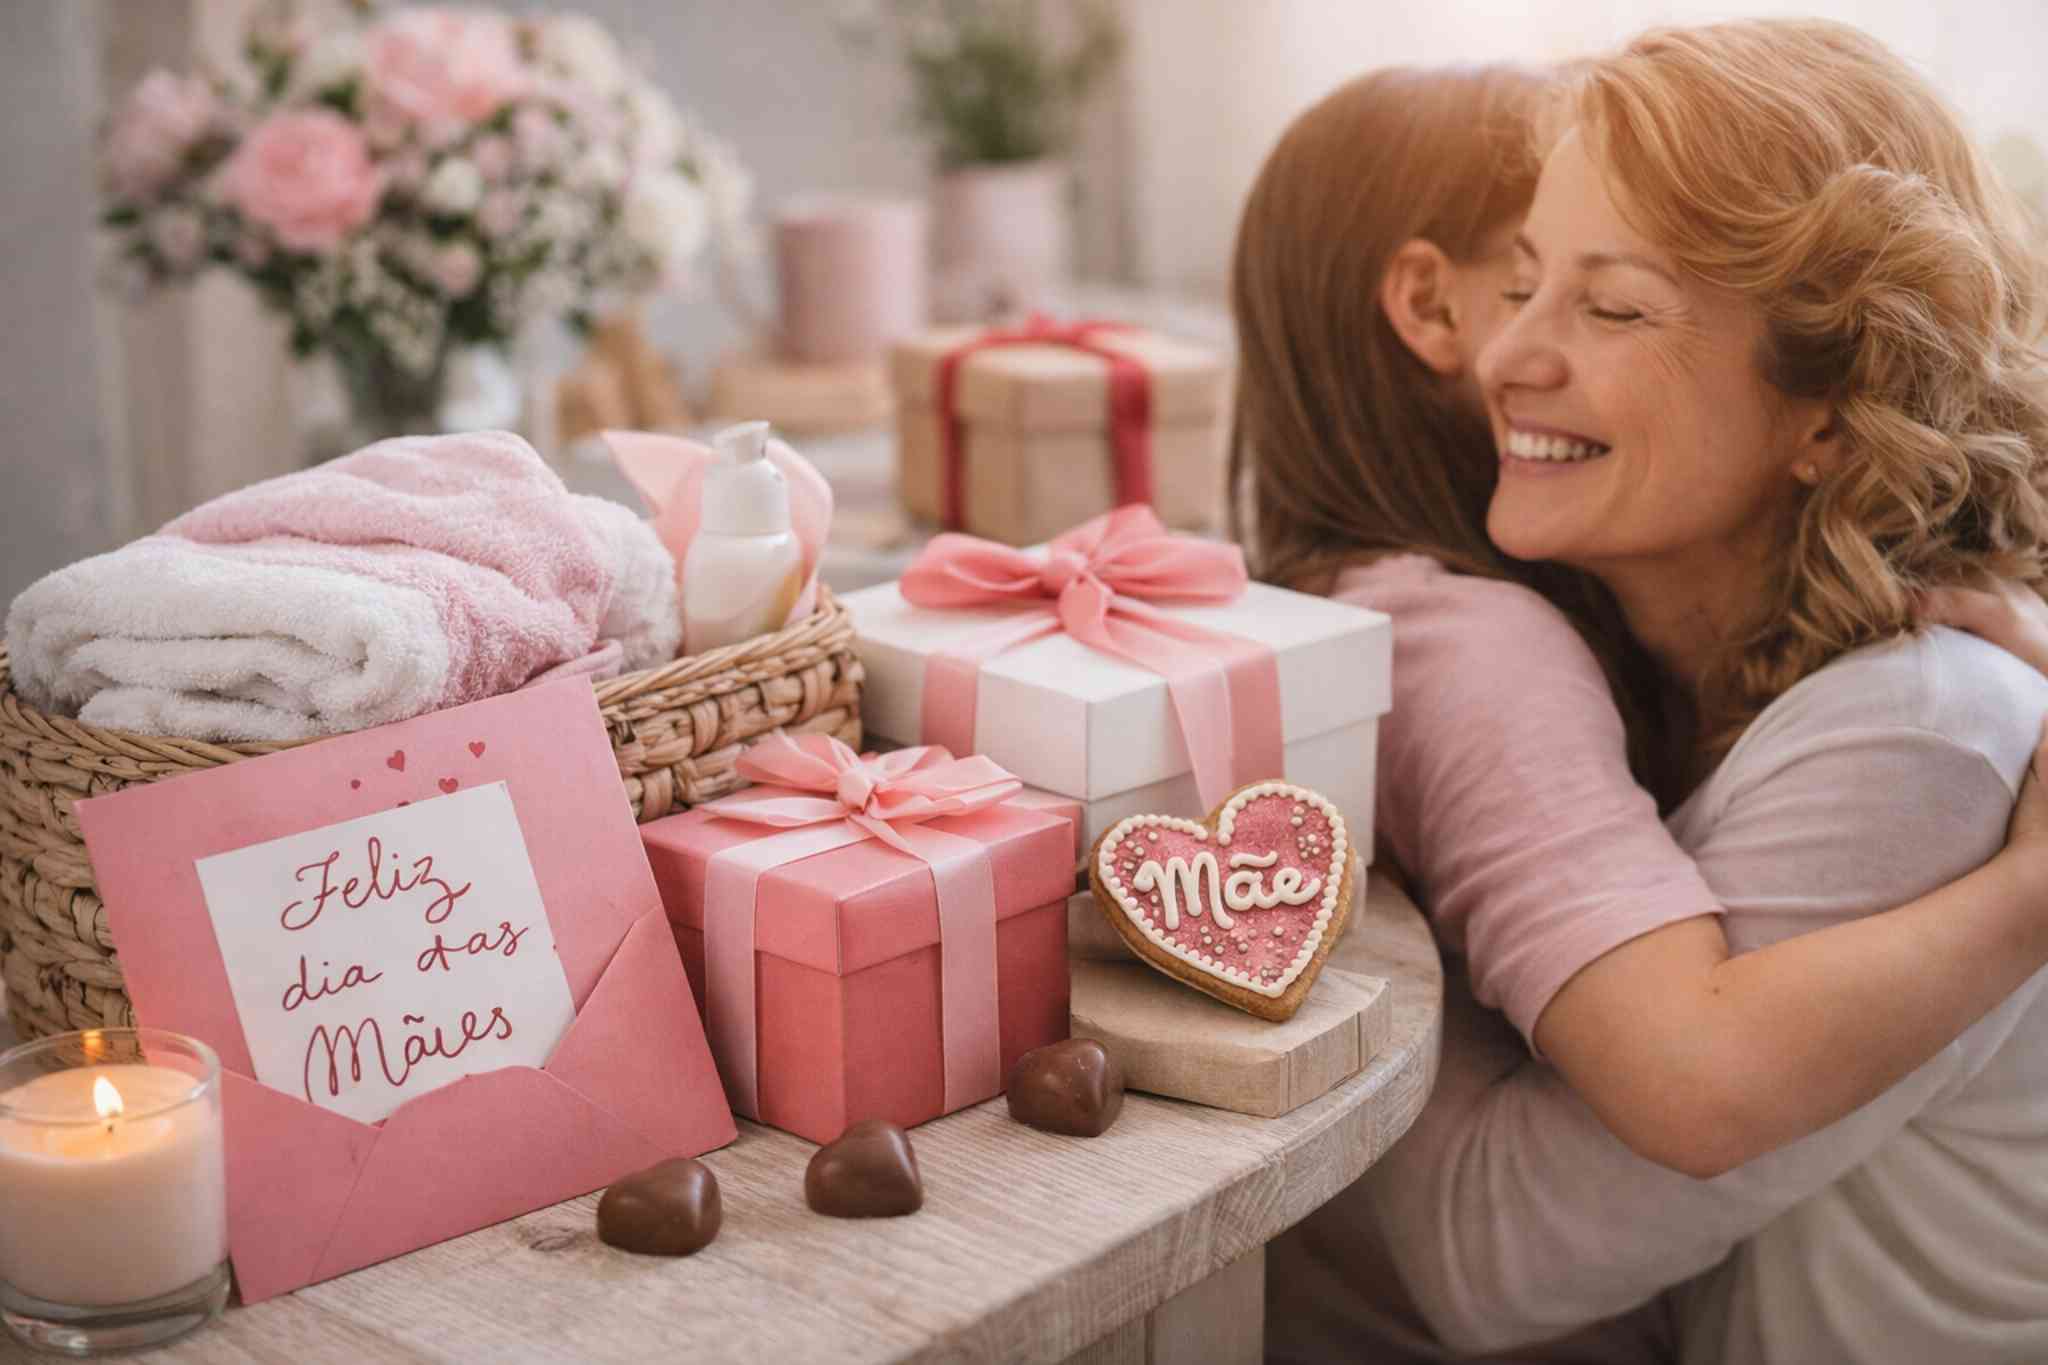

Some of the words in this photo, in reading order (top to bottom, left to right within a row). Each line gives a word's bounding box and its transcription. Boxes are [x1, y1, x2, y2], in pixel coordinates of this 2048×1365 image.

[280, 836, 472, 931] Feliz
[1133, 850, 1321, 930] Mãe
[282, 954, 384, 1012] dia
